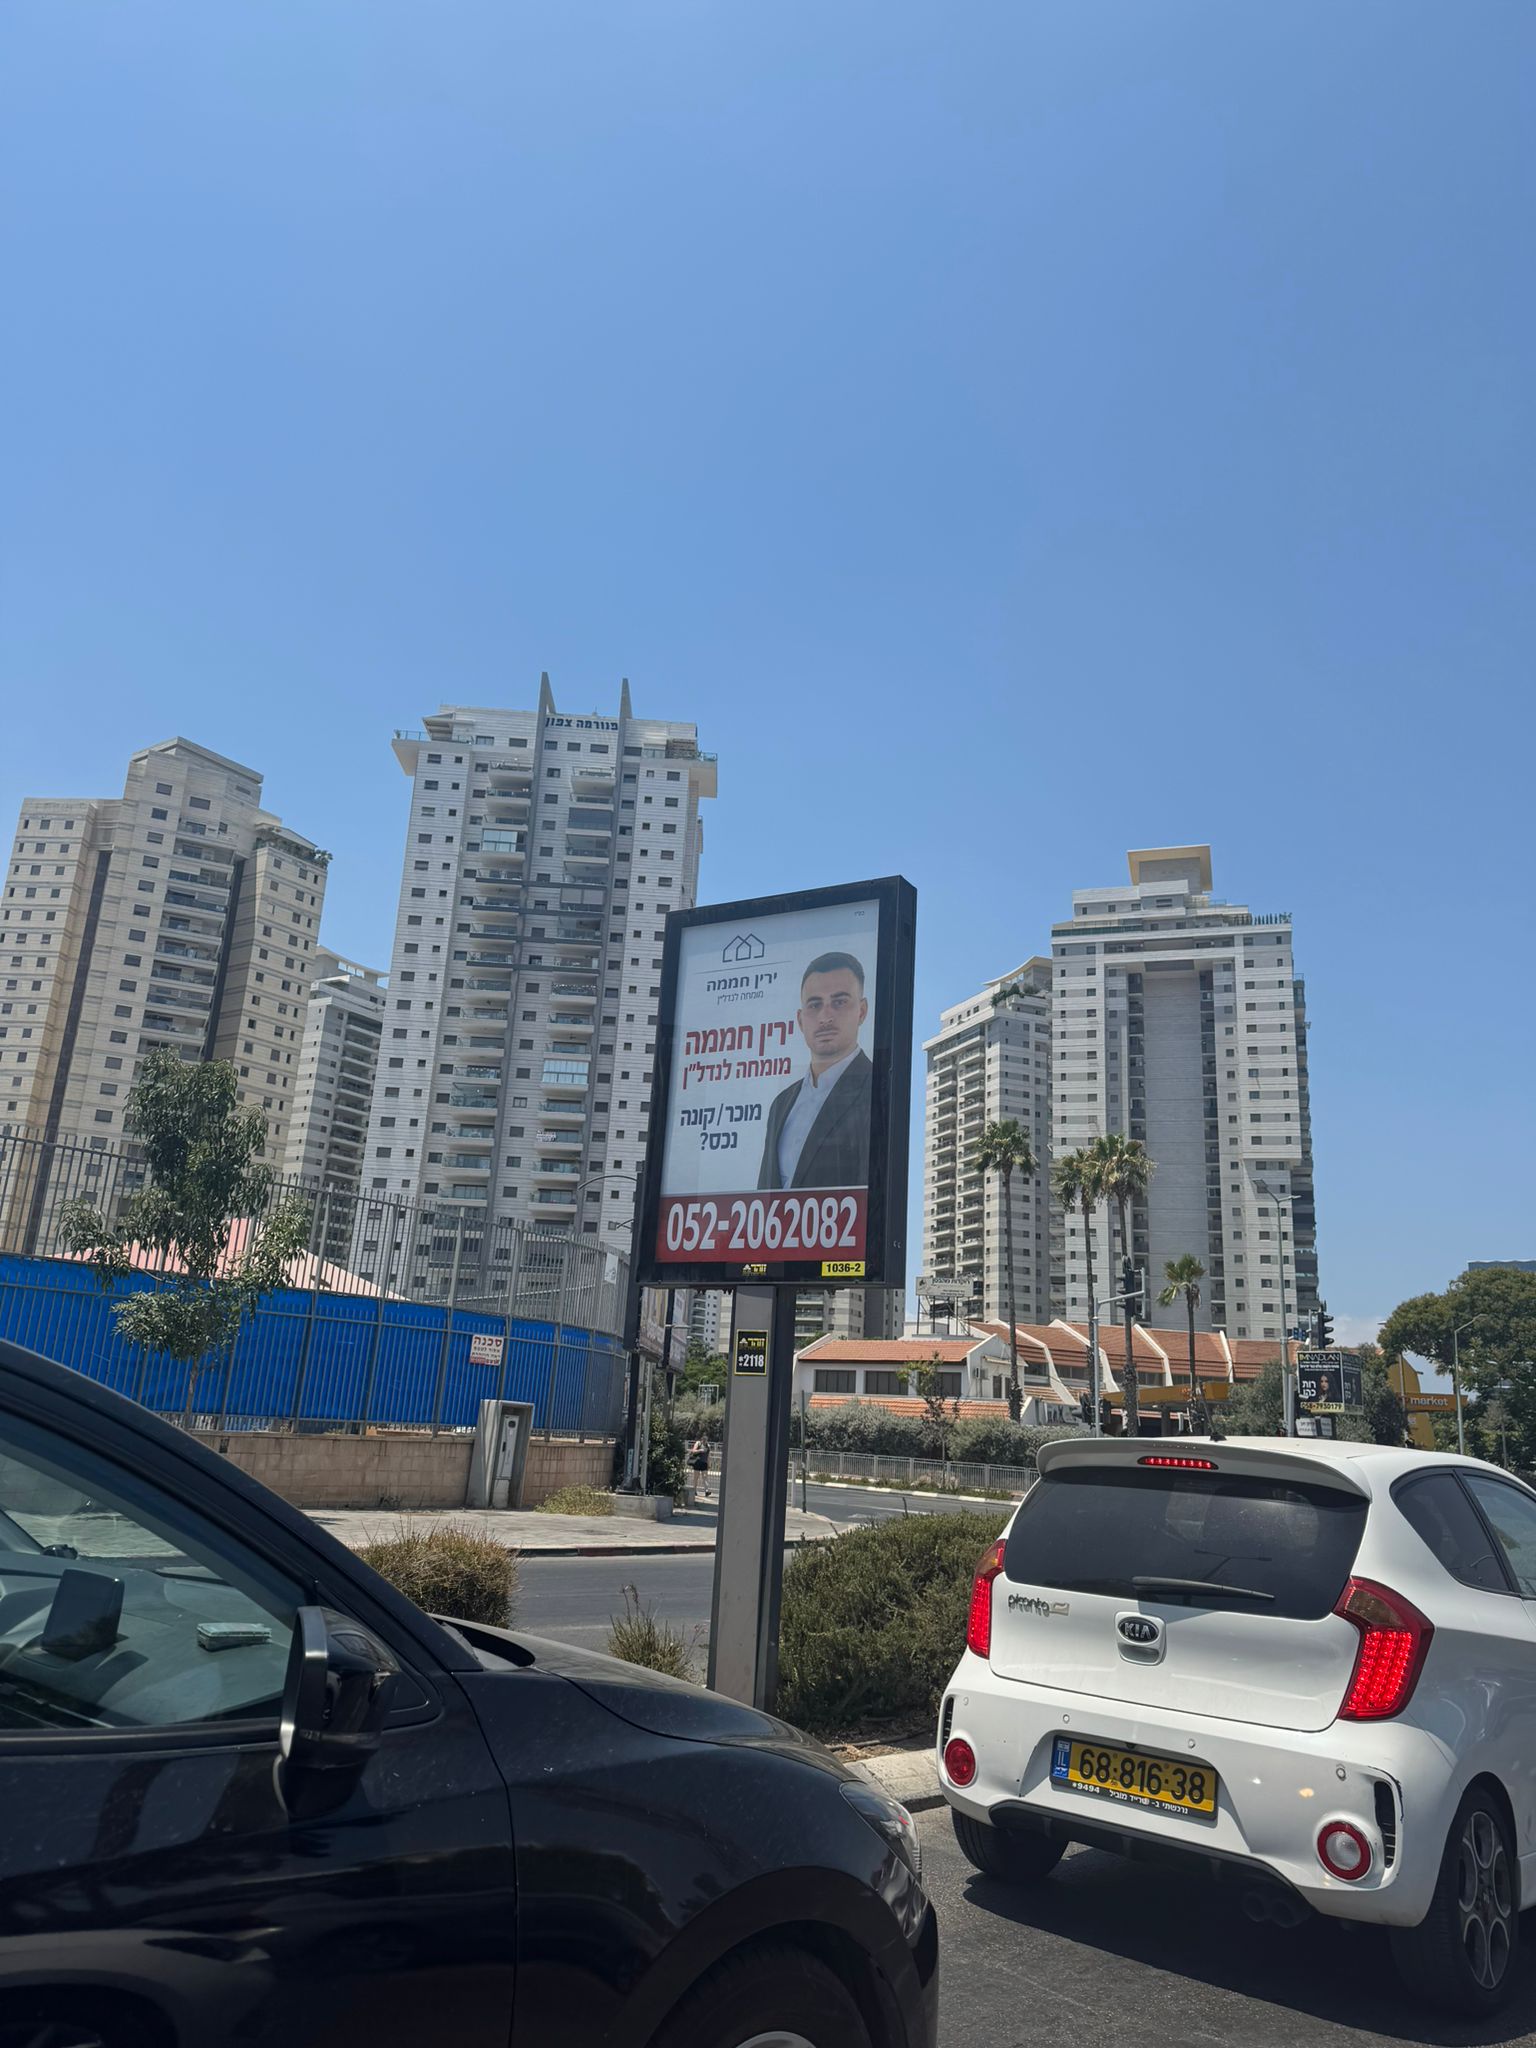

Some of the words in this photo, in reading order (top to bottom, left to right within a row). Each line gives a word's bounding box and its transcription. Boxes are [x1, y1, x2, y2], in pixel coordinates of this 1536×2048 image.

[545, 717, 573, 728] צפון
[576, 719, 618, 731] פנורמה
[706, 975, 750, 992] חממה
[754, 972, 778, 988] ירין
[740, 990, 764, 1001] מומחה
[685, 1023, 753, 1056] חממה
[758, 1020, 795, 1056] ירין
[735, 1056, 792, 1079] מומחה
[680, 1103, 762, 1130] מוכר/קונה
[700, 1131, 738, 1151] נכס?
[666, 1196, 858, 1251] 052-2062082
[826, 1262, 861, 1273] 1036-2
[474, 1336, 502, 1348] סכנה
[1302, 1380, 1317, 1389] רות
[1410, 1396, 1449, 1406] market
[1124, 1622, 1151, 1639] KIA
[1109, 1789, 1128, 1800] מוביל
